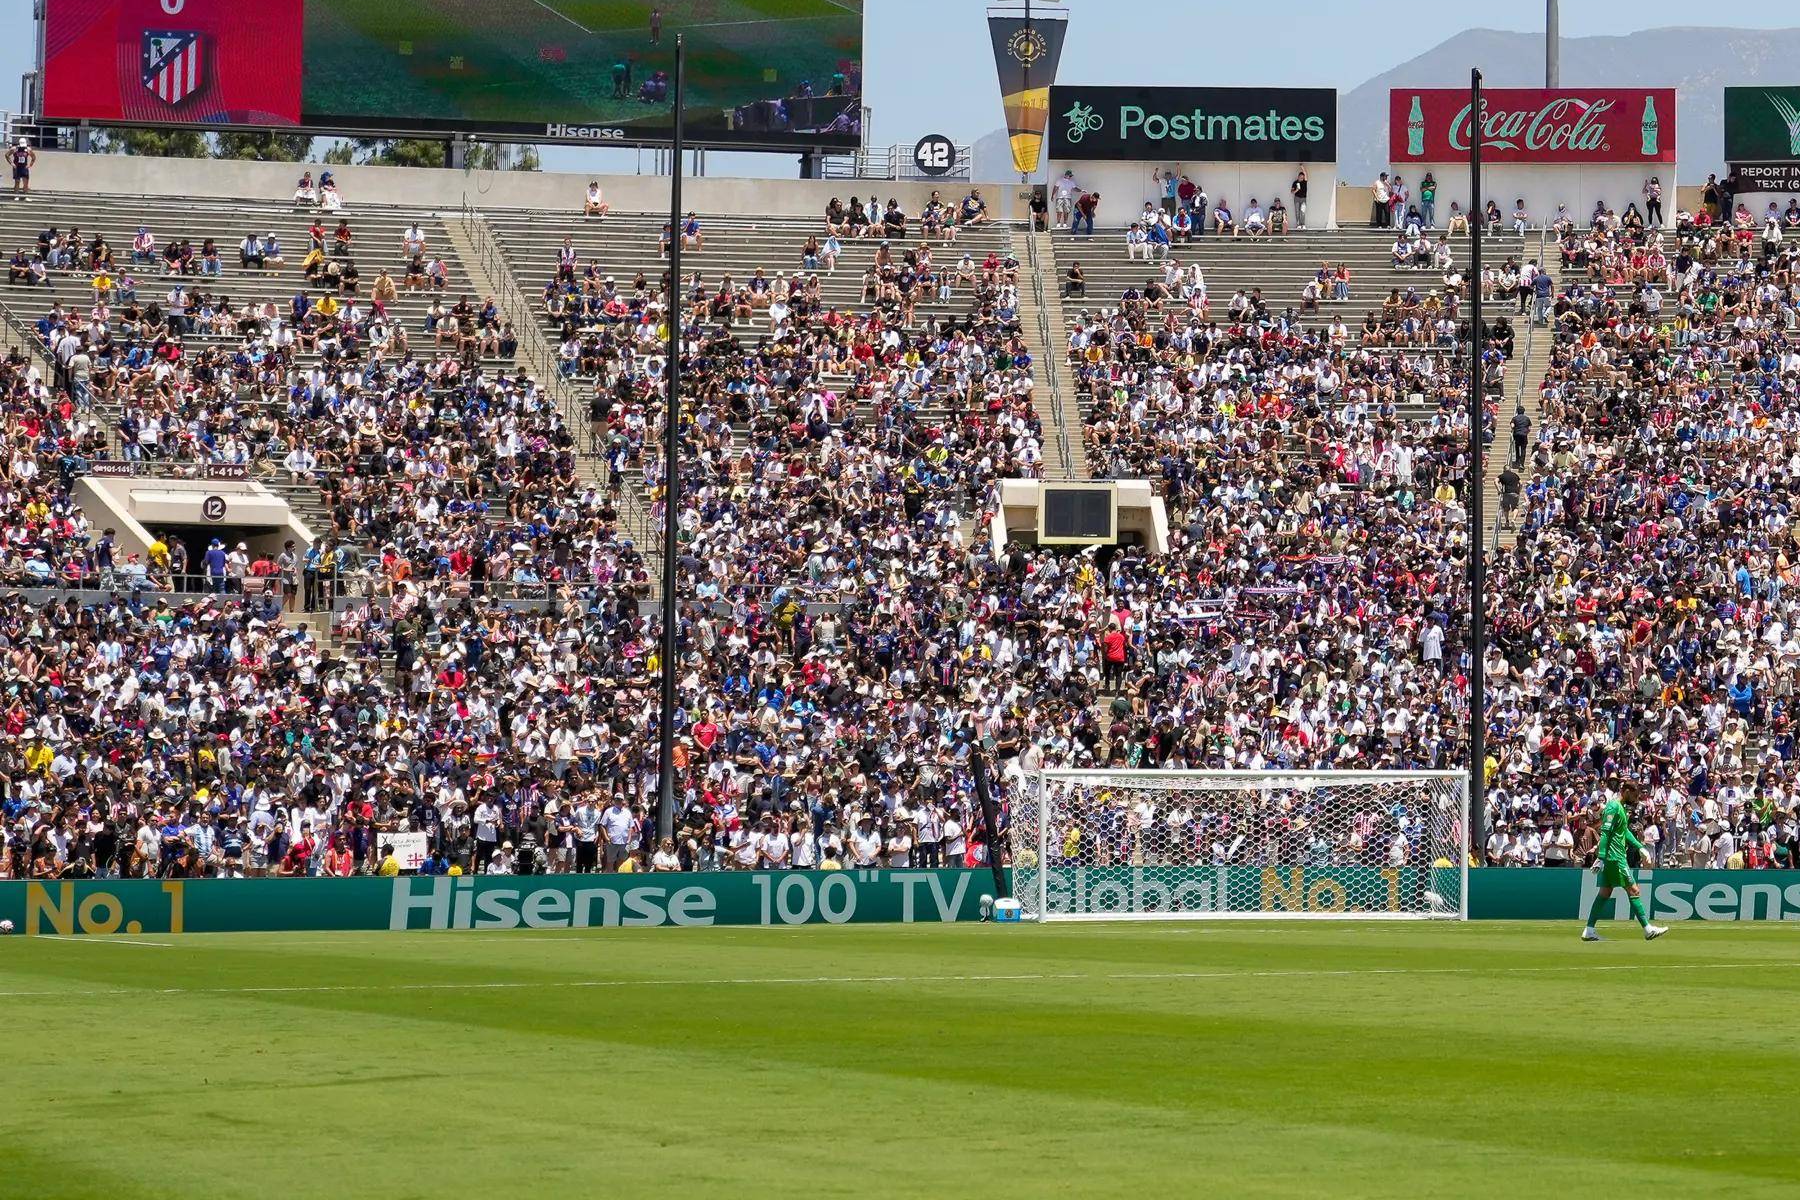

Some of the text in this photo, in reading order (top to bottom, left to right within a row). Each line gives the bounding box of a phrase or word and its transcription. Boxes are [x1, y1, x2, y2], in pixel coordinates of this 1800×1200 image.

[546, 123, 624, 139] Hisense
[1119, 105, 1325, 142] Postmates
[1449, 98, 1615, 151] Coca-Cola
[918, 143, 949, 167] 42
[1740, 167, 1787, 177] REPORT
[1755, 179, 1784, 189] TEXT
[209, 467, 233, 477] 1-41
[207, 501, 222, 516] 12
[390, 876, 716, 930] Hisense
[752, 873, 879, 924] 100"
[1027, 867, 1228, 912] Global
[1381, 867, 1399, 912] 1
[26, 881, 184, 935] No. 1
